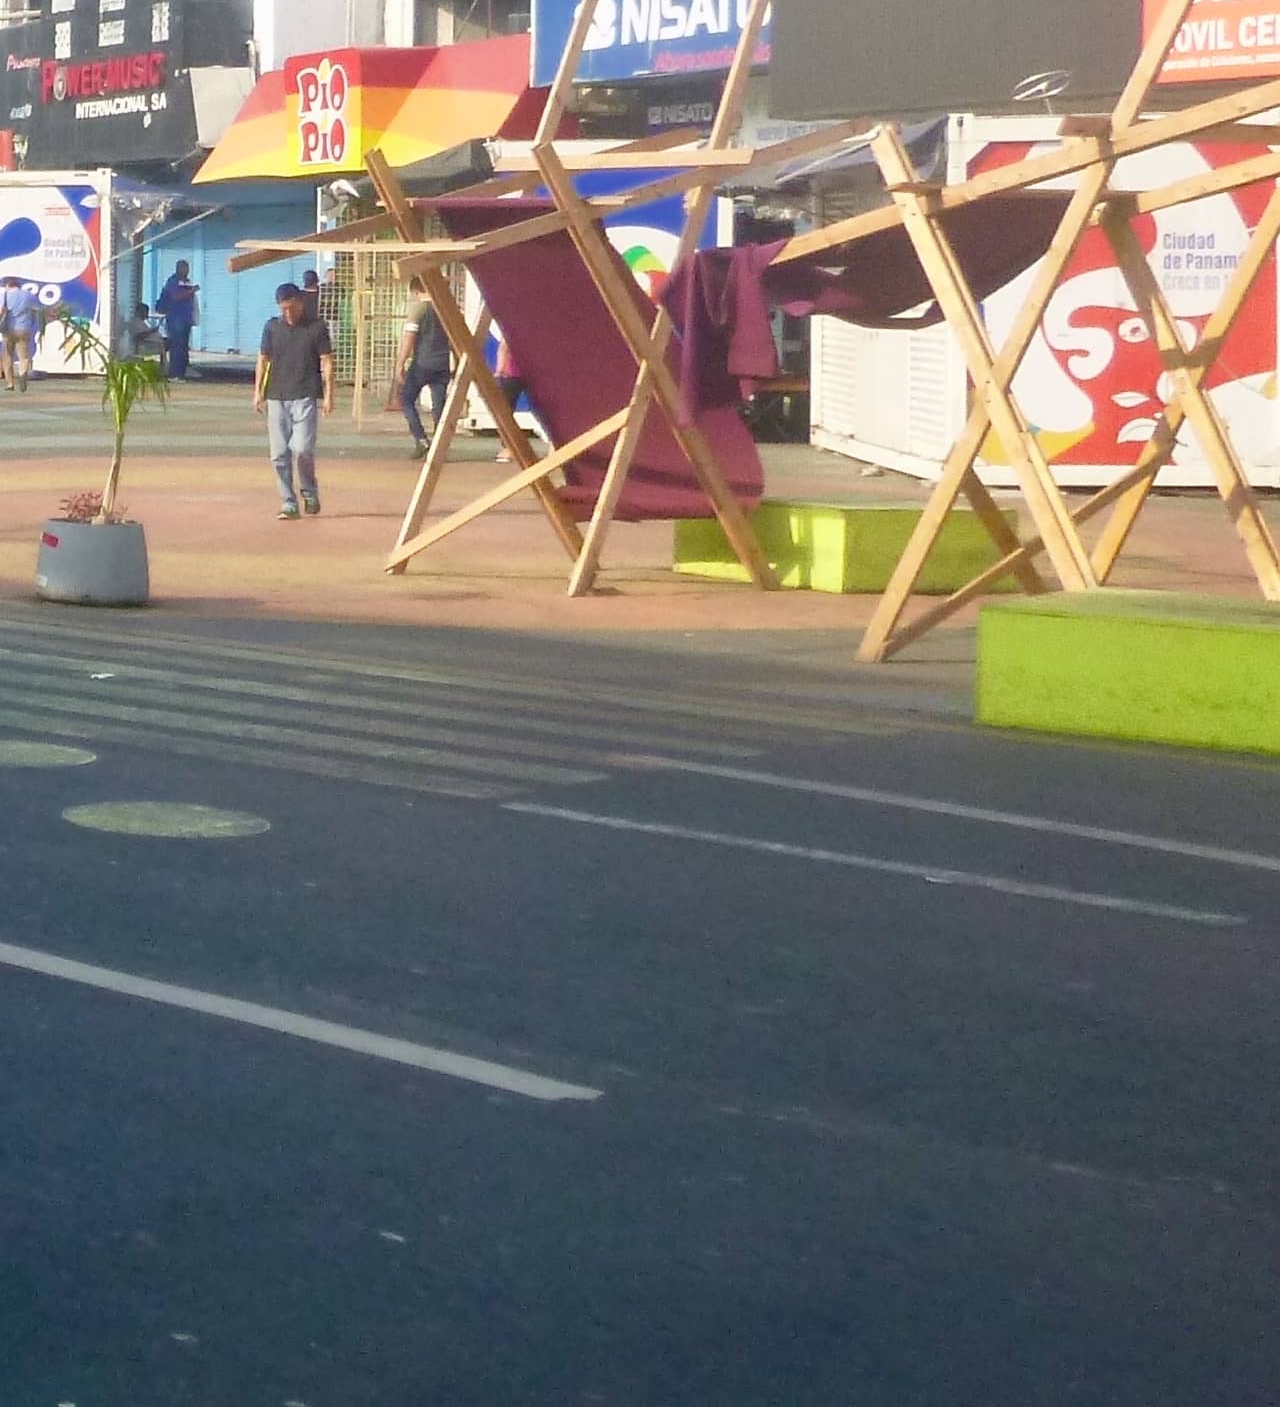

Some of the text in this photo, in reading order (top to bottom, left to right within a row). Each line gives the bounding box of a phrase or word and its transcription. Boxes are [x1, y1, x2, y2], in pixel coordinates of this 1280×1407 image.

[1170, 14, 1280, 54] OVIL CE
[1162, 233, 1216, 250] Ciudad
[1162, 253, 1182, 270] de
